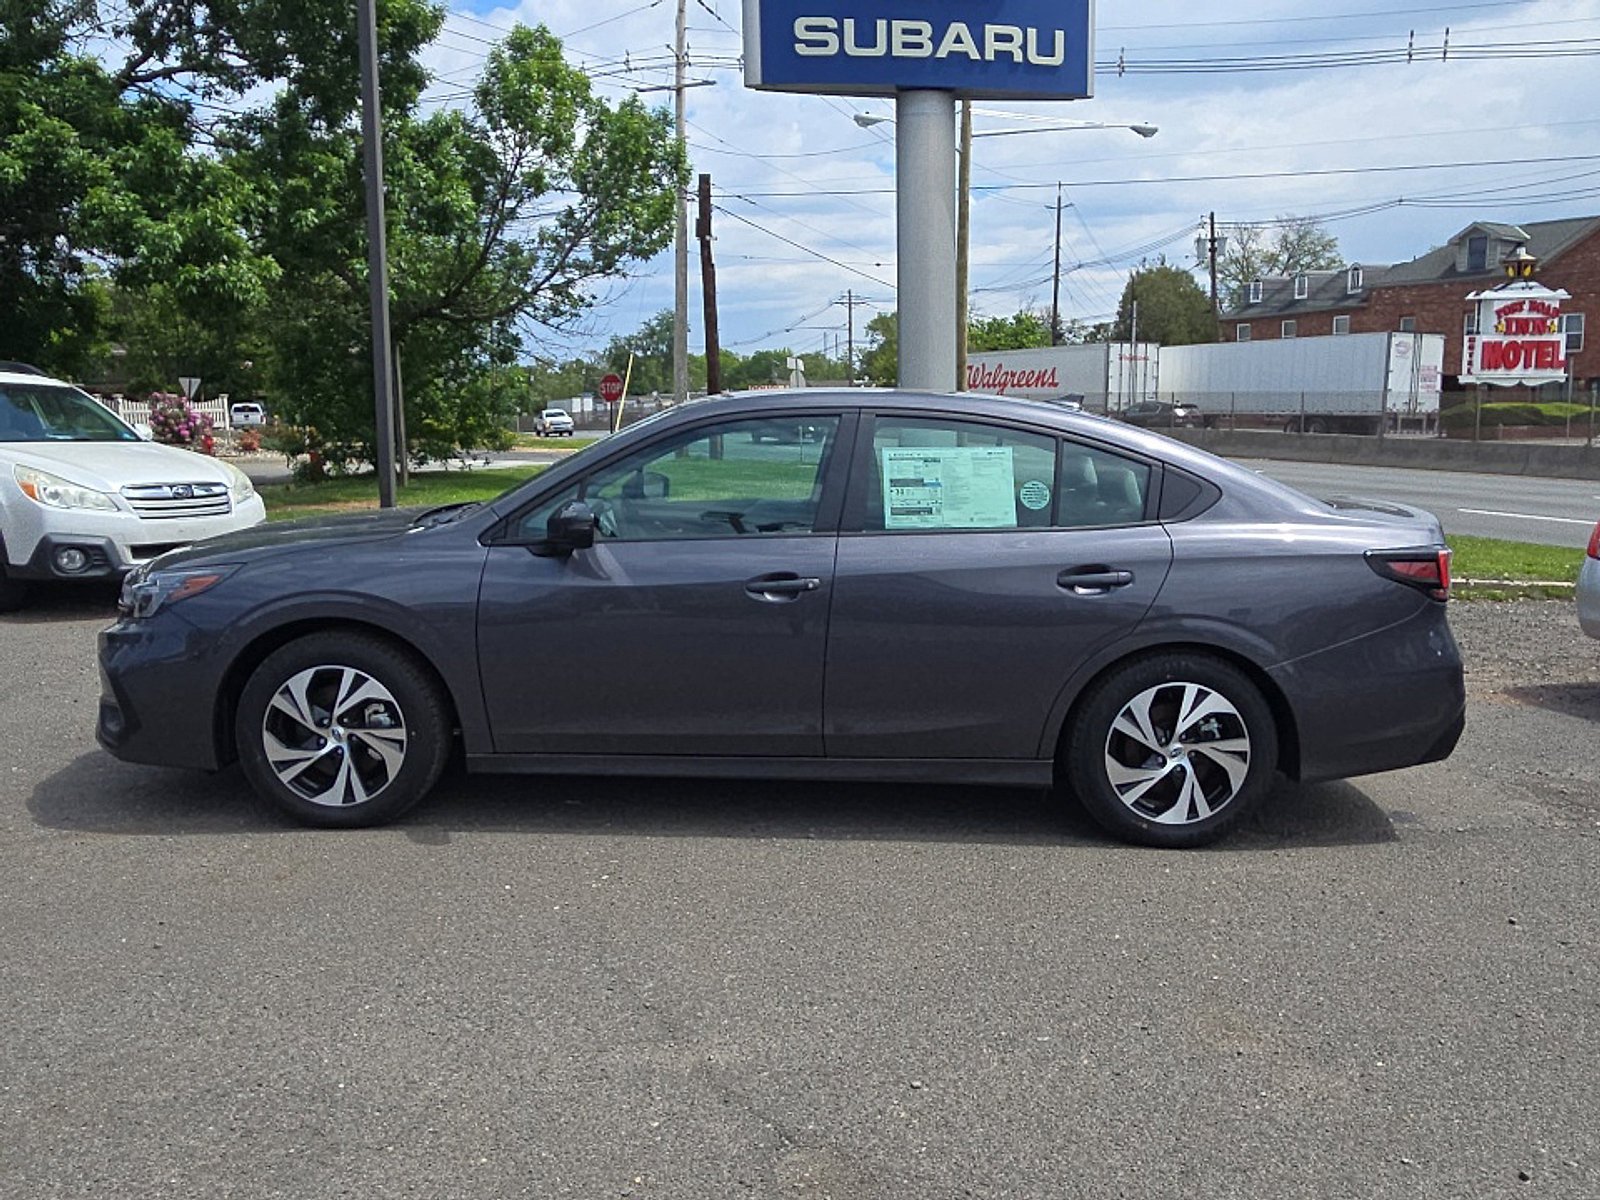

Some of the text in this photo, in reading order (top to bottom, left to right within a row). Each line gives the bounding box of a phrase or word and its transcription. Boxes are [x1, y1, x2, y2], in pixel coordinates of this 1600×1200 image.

[793, 16, 1065, 66] SUBARU
[1504, 317, 1549, 335] INN
[1481, 340, 1568, 370] MOTEL
[601, 382, 621, 394] STOP
[966, 362, 1060, 396] Walgreens
